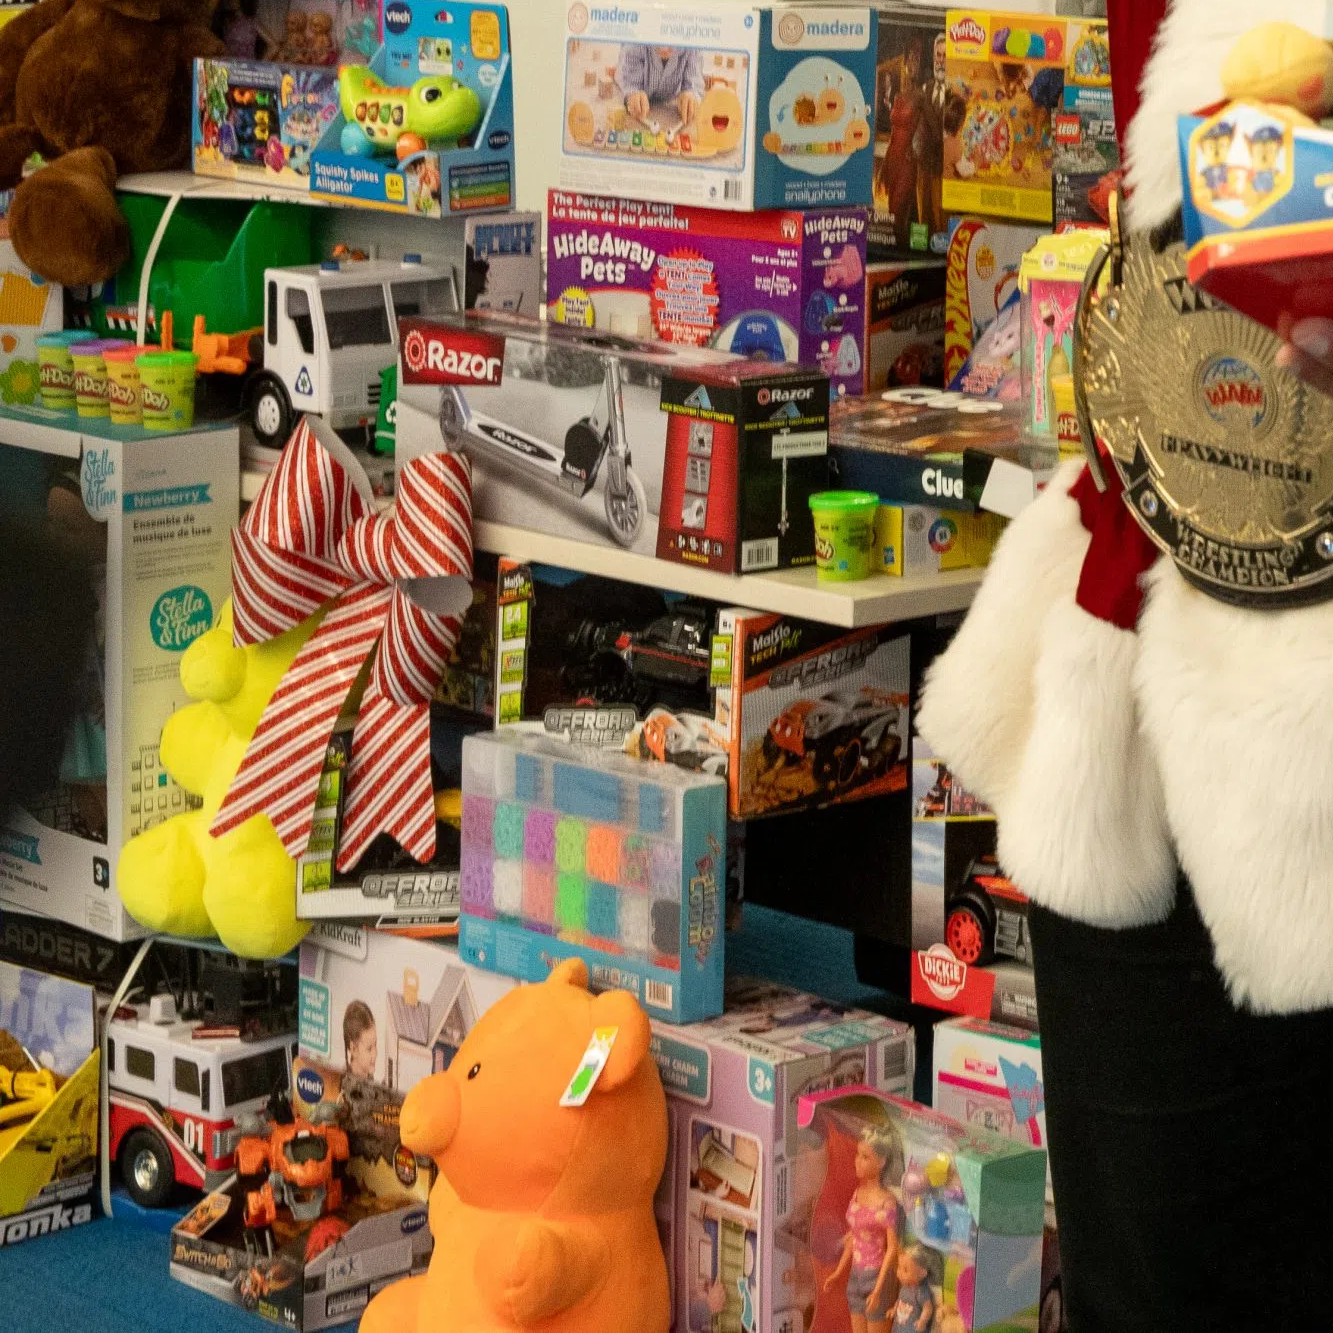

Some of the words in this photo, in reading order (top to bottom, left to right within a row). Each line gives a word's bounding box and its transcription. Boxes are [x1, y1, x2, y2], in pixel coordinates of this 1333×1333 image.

[386, 9, 411, 24] vtech
[590, 7, 639, 23] madera
[806, 20, 864, 36] madera
[1058, 123, 1077, 136] LEGO
[316, 176, 353, 194] Alligator
[350, 169, 379, 184] Spikes
[553, 192, 572, 206] The
[576, 195, 616, 210] Perfect
[620, 199, 643, 214] Play
[553, 206, 566, 218] La
[569, 209, 598, 222] tente
[601, 211, 615, 223] de
[804, 215, 865, 237] HideAway
[820, 230, 848, 244] Pets
[553, 229, 656, 273] HideAway
[580, 255, 627, 284] Pets
[428, 339, 500, 382] Razor
[772, 387, 814, 404] Razor
[86, 449, 116, 483] Stella
[134, 488, 201, 508] Newberry
[183, 515, 195, 525] de
[1176, 516, 1295, 566] WRESTLING
[1178, 542, 1290, 587] CHAMPION
[156, 588, 205, 624] Stella
[752, 623, 791, 654] Maisto
[544, 707, 636, 732] OFFROAD
[320, 922, 362, 947] KidKraft
[924, 957, 961, 982] DICKIE
[298, 1077, 323, 1093] vtech
[754, 1067, 773, 1093] 3+
[183, 1118, 205, 1152] 01
[0, 1203, 92, 1246] Tonka
[401, 1213, 427, 1228] vtech
